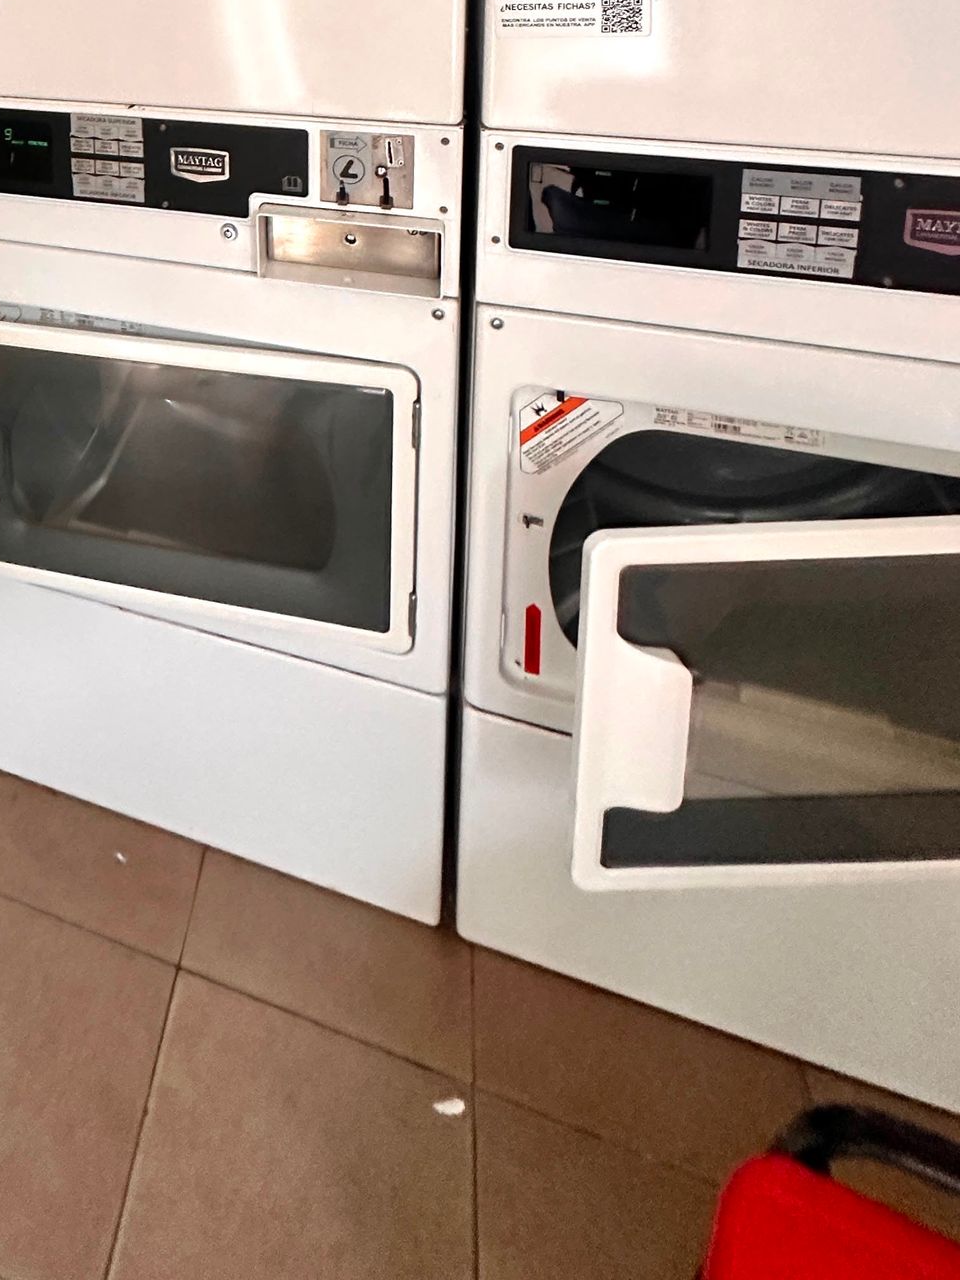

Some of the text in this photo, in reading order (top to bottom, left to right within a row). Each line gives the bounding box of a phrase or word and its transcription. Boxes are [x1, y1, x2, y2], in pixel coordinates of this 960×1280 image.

[500, 2, 596, 13] ¿NECESITAS FICHAS?
[177, 154, 223, 168] MAYTAG
[747, 260, 840, 274] SECADORA INFERIOR
